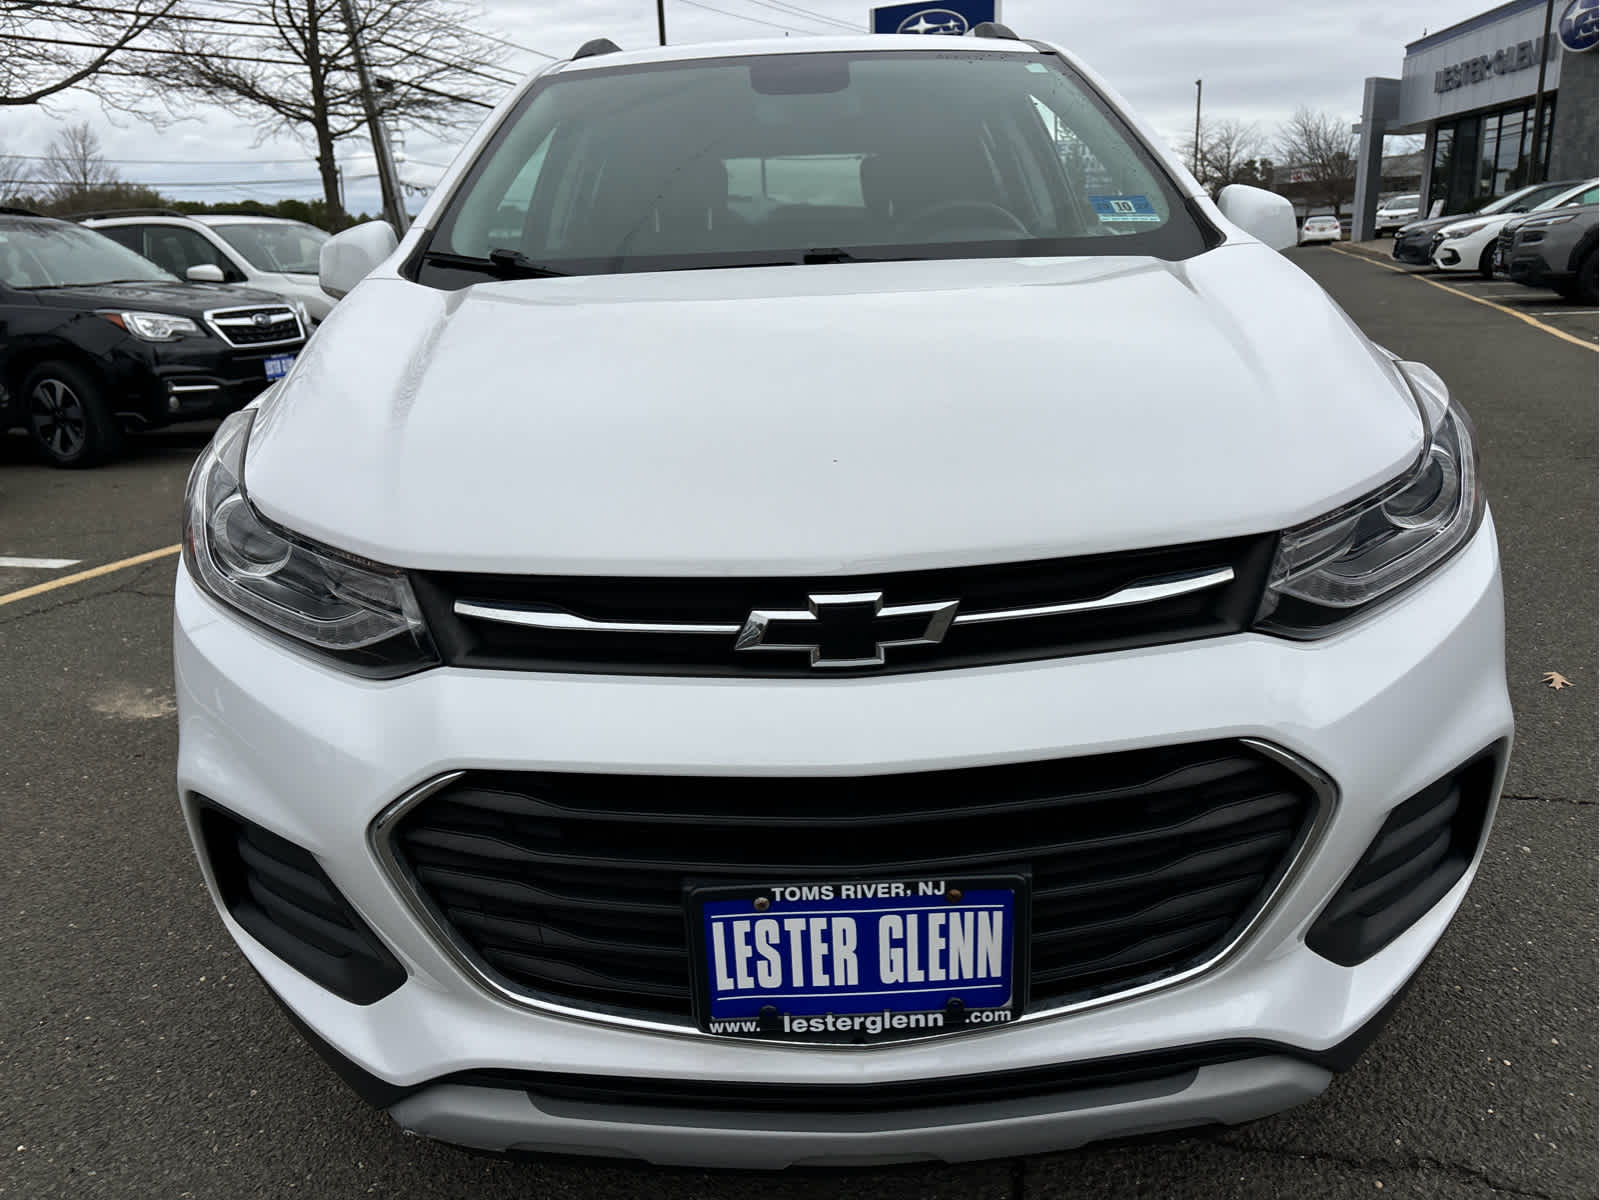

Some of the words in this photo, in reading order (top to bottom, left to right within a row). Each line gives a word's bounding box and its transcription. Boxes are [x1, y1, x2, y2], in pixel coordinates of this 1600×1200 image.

[1434, 54, 1493, 94] LESTER
[1115, 201, 1132, 212] 10
[771, 886, 834, 902] TOMS
[841, 882, 912, 899] RIVER,
[918, 880, 946, 896] NJ
[711, 916, 859, 991] LESTER
[878, 910, 1003, 985] GLENN
[709, 1020, 761, 1034] www.
[783, 1010, 944, 1034] lesterglenn
[964, 1008, 1012, 1024] .com
